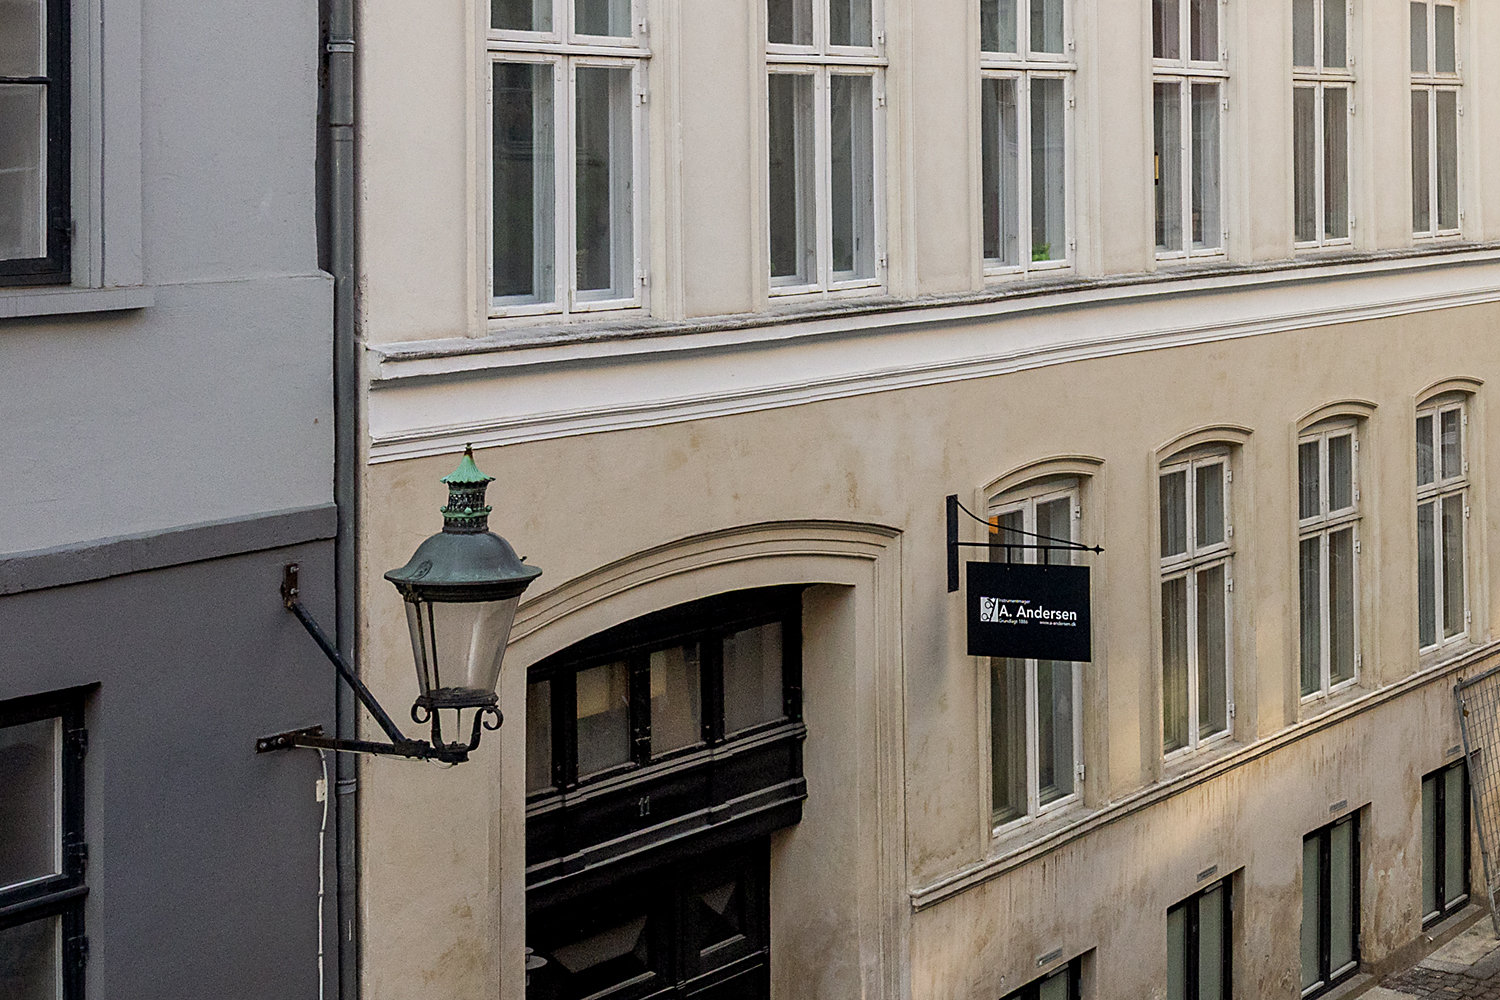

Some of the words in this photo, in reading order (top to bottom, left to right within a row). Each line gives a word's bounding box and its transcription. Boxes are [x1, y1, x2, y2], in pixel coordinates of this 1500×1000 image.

[999, 604, 1012, 617] A.
[1016, 605, 1077, 621] Andersen
[638, 795, 650, 817] 11
